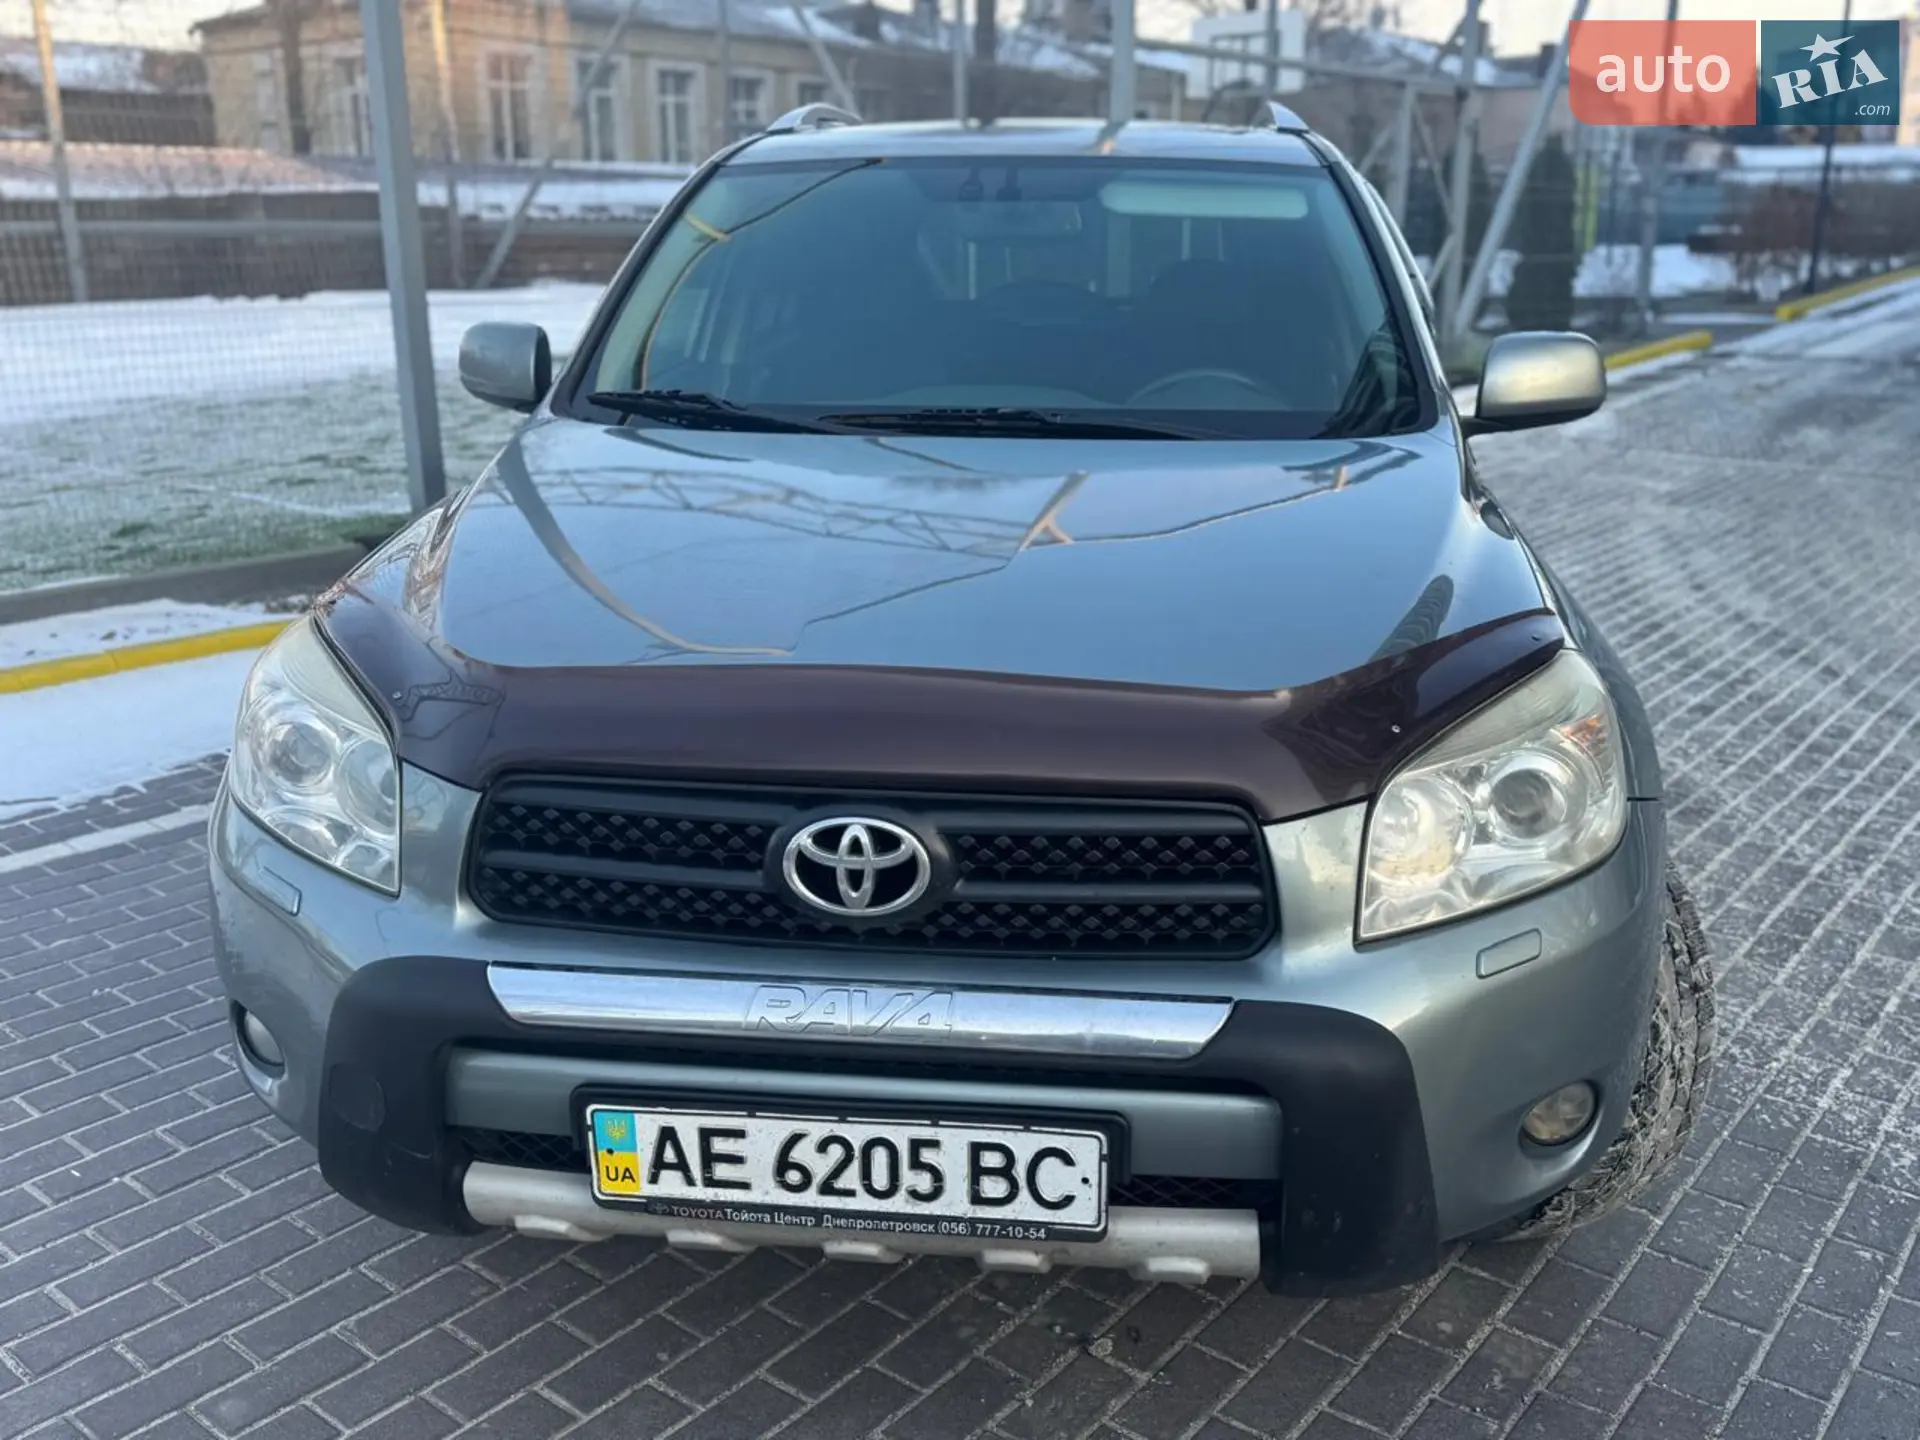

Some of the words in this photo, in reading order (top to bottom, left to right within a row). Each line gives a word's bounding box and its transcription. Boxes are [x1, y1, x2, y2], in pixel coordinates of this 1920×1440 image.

[742, 984, 953, 1037] RAV4
[605, 1165, 636, 1183] UA
[647, 1125, 752, 1190] AE
[774, 1132, 945, 1203] 6205
[969, 1141, 1077, 1211] BC
[671, 1205, 725, 1220] TOYOTA
[725, 1208, 771, 1224] Тойота
[774, 1212, 815, 1227] Центр
[822, 1214, 935, 1234] Днепропетровск
[938, 1220, 972, 1236] (056)
[975, 1223, 1047, 1240] 777-10-54
